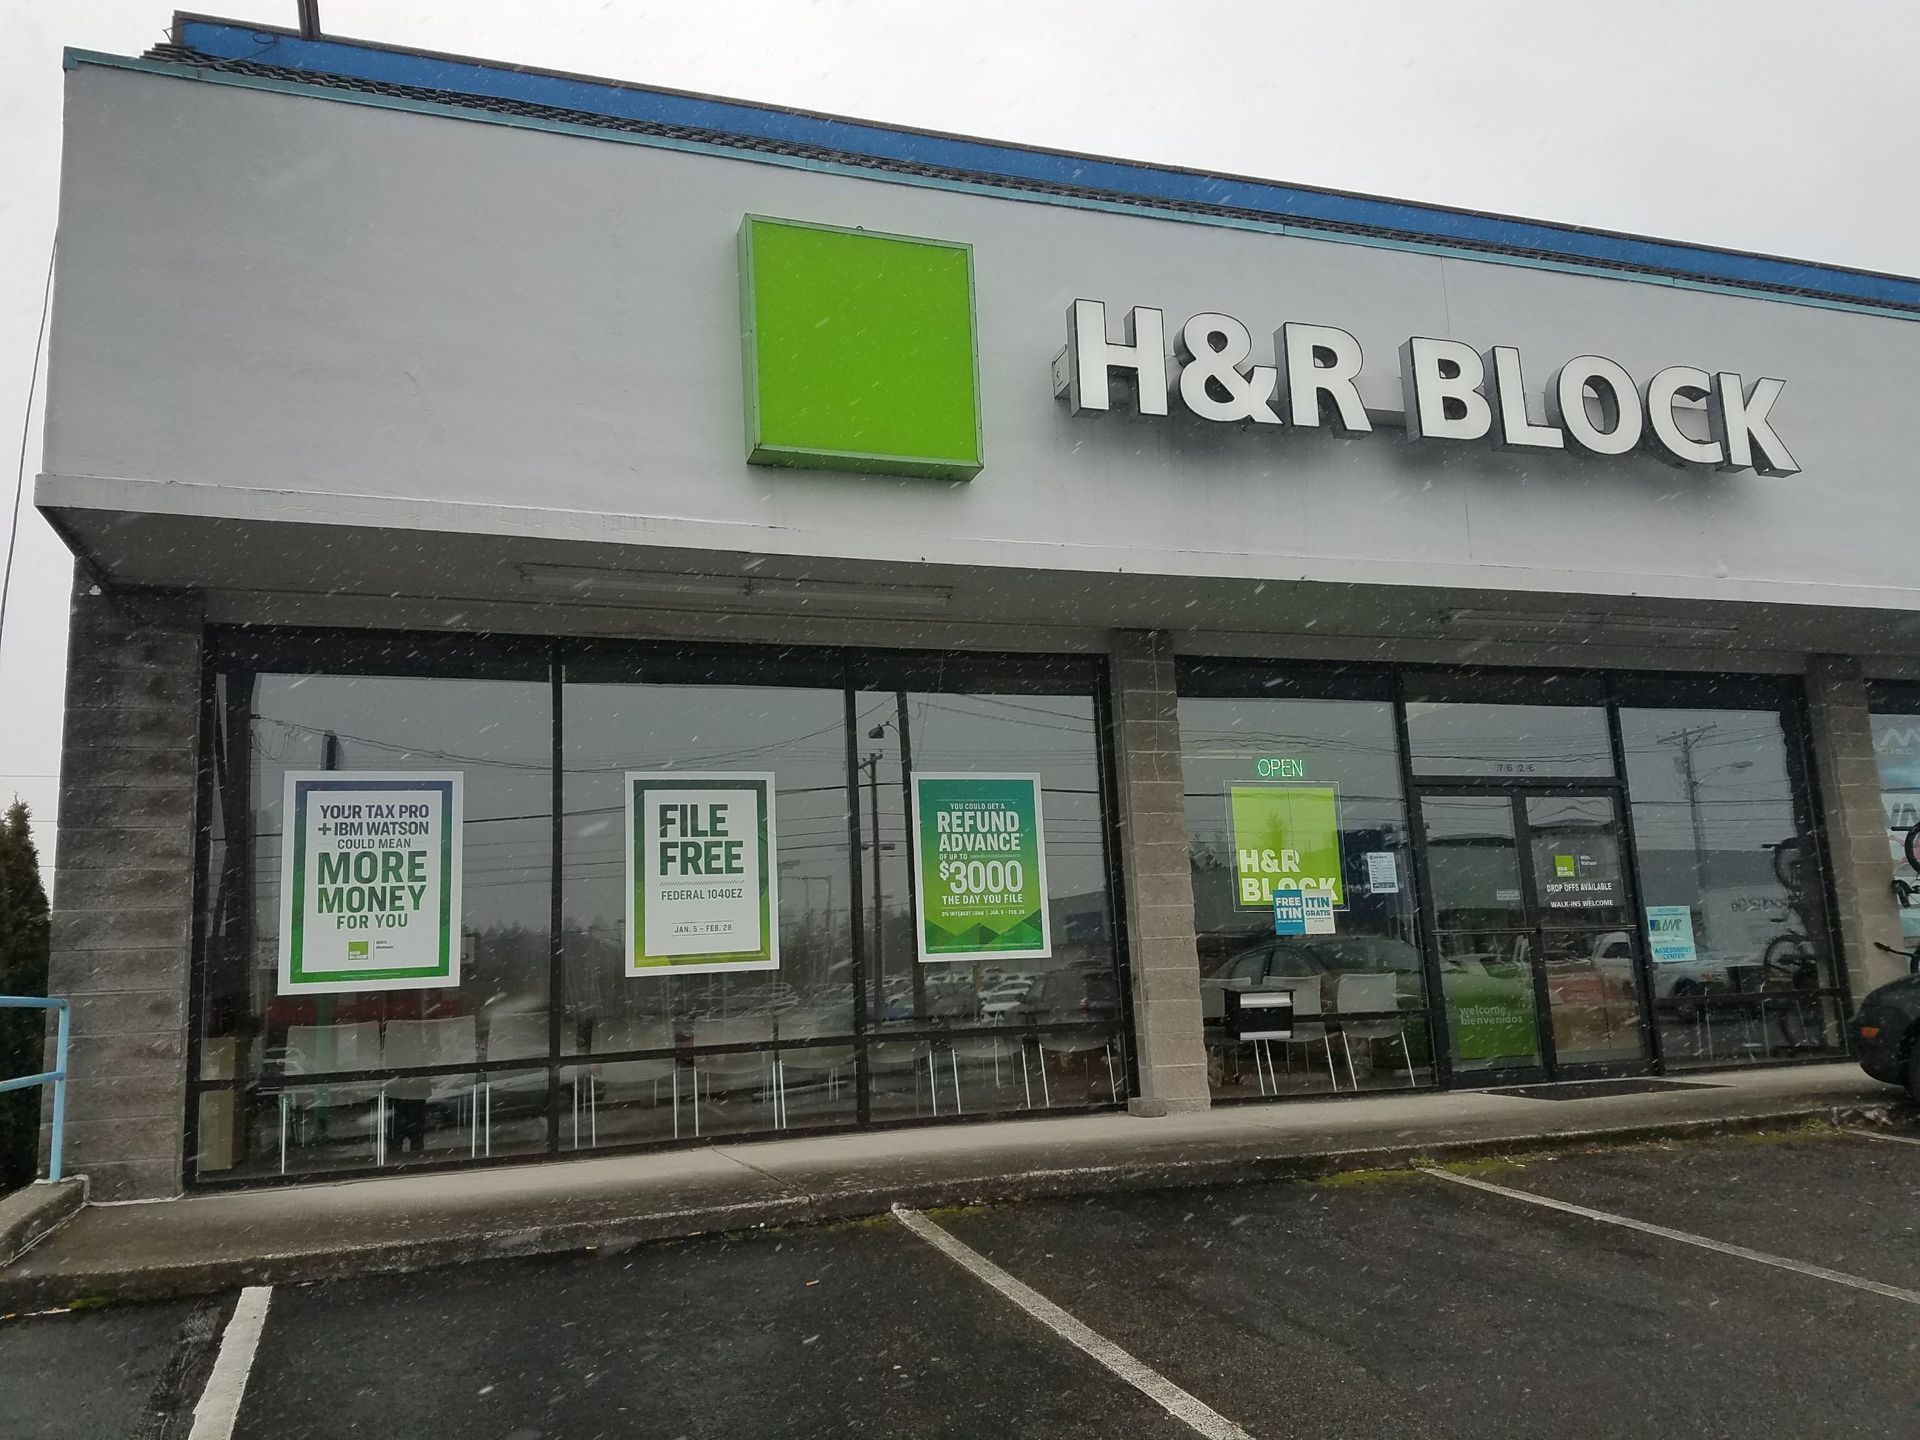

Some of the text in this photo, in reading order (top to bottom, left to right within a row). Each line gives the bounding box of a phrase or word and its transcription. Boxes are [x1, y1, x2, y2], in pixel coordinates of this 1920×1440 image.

[1072, 298, 1802, 476] H&R BLOCK
[1257, 758, 1303, 777] OPEN
[320, 804, 430, 819] YOUR TAX PRO
[659, 803, 729, 838] FILE
[937, 811, 1020, 832] REFUND
[366, 821, 429, 836] WATSON
[337, 838, 411, 849] COULD MEAN
[659, 840, 744, 876] FREE
[1239, 848, 1301, 873] H&R
[318, 850, 428, 885] MORE
[939, 860, 1023, 894] $3000
[1546, 882, 1613, 892] DROP OFFS AVAILABLE
[317, 884, 427, 914] MONEY
[661, 888, 743, 901] FEDERAL 1040EZ
[942, 893, 1023, 905] THE DAY YOU FILE
[1275, 896, 1301, 906] FREE
[1305, 897, 1330, 908] ITIN
[1550, 899, 1614, 908] WALK-INS WELCOME
[1276, 907, 1302, 919] ITIN
[1305, 909, 1331, 917] GRATIS
[336, 913, 408, 930] FOR YOU
[674, 925, 692, 934] JAN.
[692, 925, 698, 933] 5
[706, 924, 722, 932] FEB.
[723, 924, 732, 932] 28
[1460, 1004, 1506, 1015] welcome
[1460, 1012, 1523, 1025] bienvenidos
